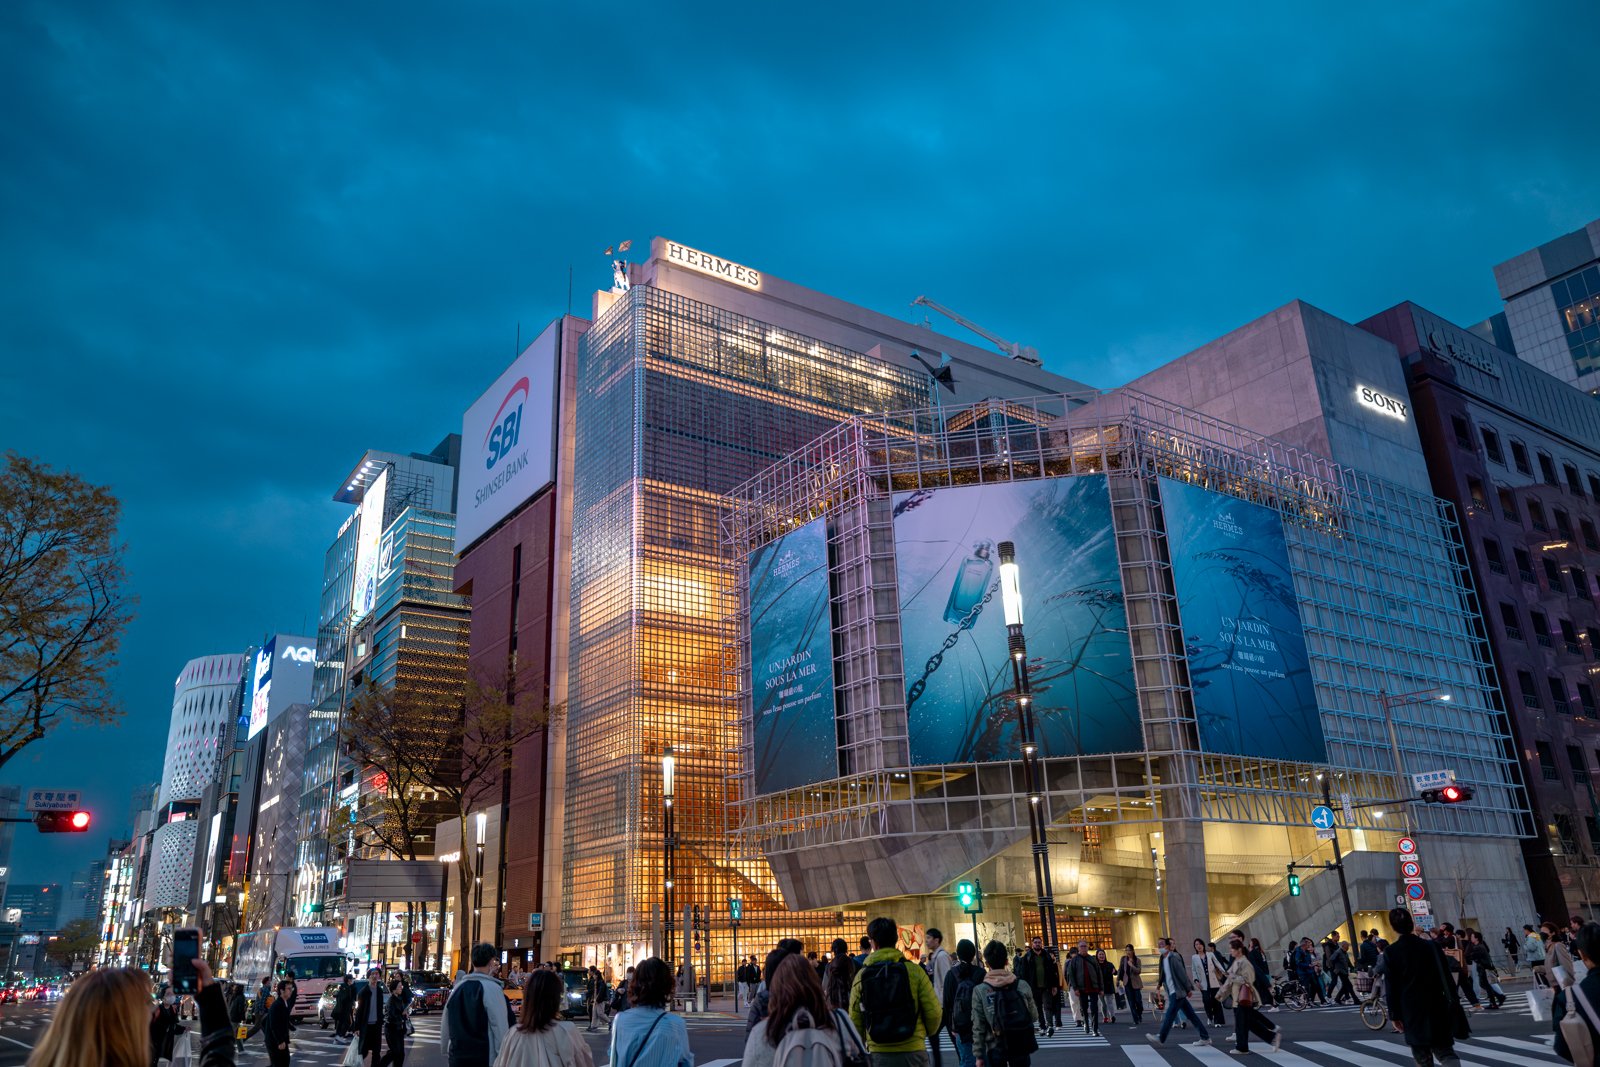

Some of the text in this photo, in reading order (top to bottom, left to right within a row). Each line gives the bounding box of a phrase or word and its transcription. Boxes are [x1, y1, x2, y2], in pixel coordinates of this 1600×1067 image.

[1361, 387, 1407, 417] SONY
[487, 403, 523, 470] SBI
[506, 450, 529, 482] BANK
[1221, 616, 1270, 635] UN JARDIN
[1219, 631, 1277, 652] SOUS LA MER
[768, 648, 812, 673] UN JARDIN
[765, 663, 817, 690] SOUS LA MER
[35, 801, 73, 809] Sukiyabashi
